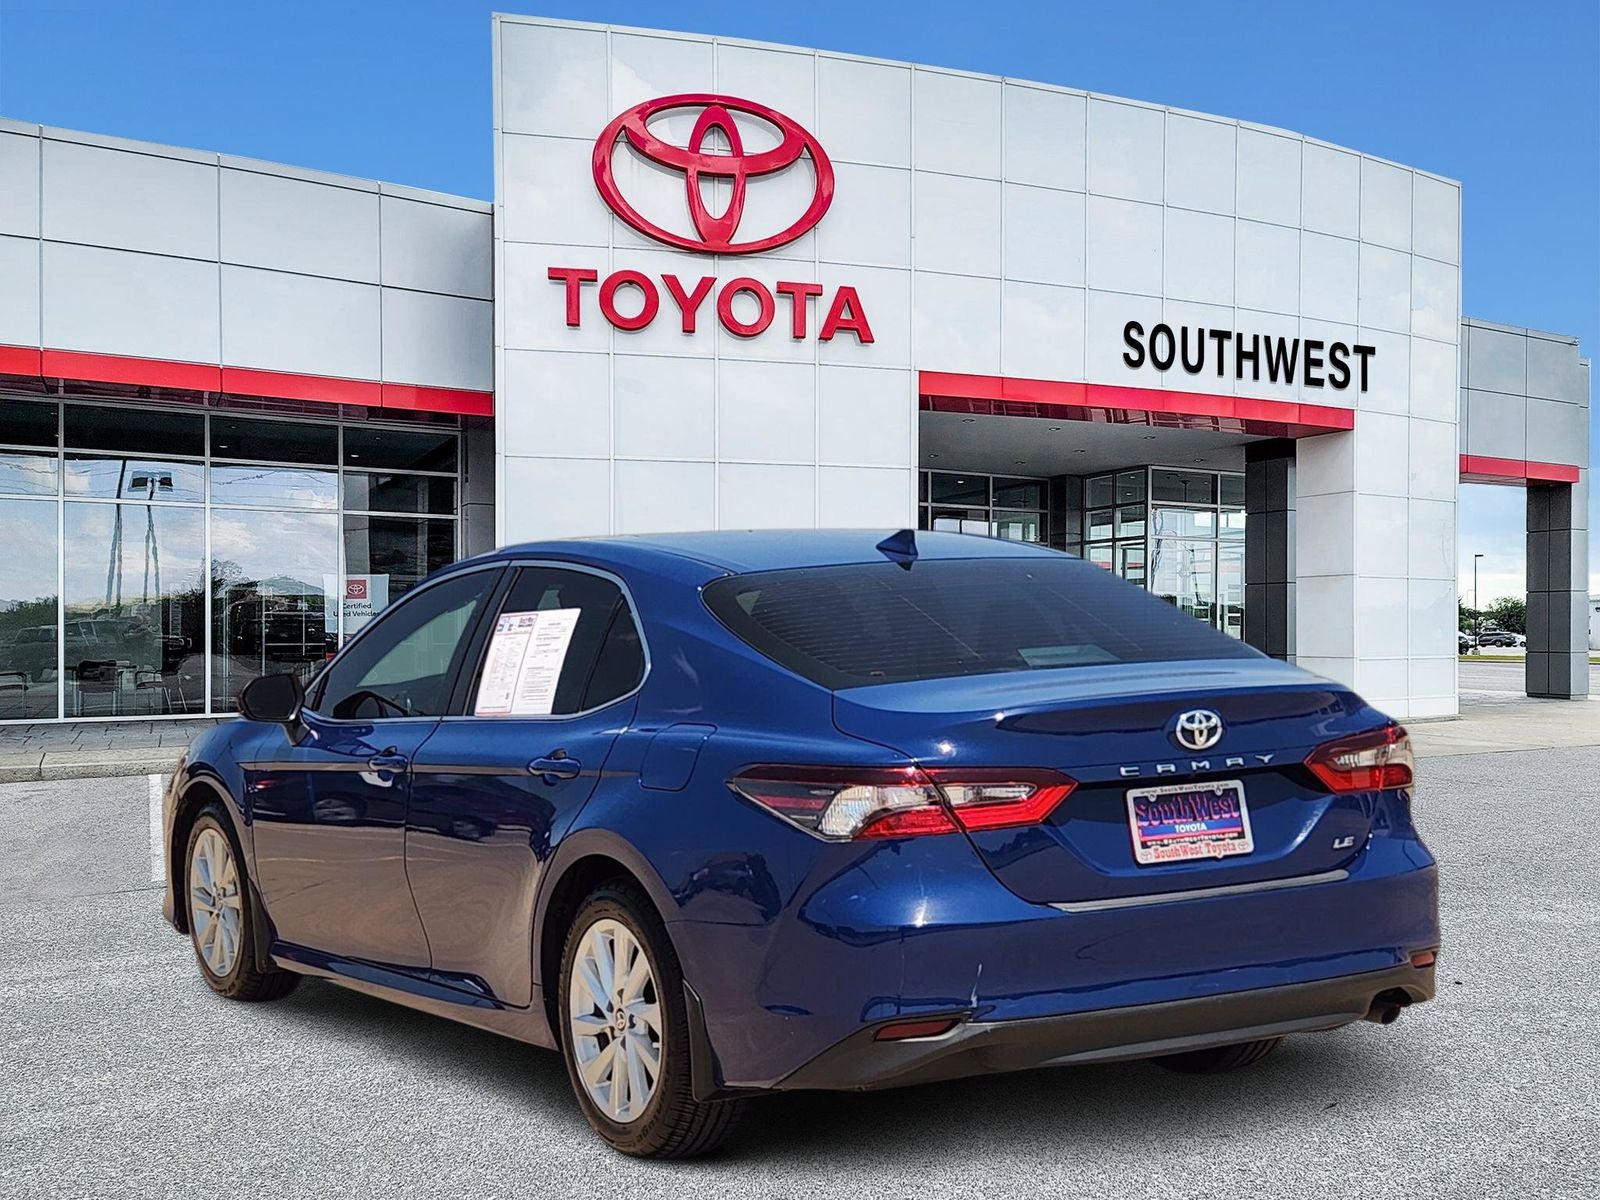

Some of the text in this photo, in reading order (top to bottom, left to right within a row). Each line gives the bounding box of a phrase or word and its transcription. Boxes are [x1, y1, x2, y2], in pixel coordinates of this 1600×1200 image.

[547, 266, 875, 344] TOYOTA
[1122, 320, 1376, 392] SOUTHWEST
[1120, 753, 1275, 776] CAMRY
[1174, 822, 1207, 833] TOYOTA
[1153, 842, 1236, 859] SouthWest Toyota
[1333, 836, 1354, 849] LE
